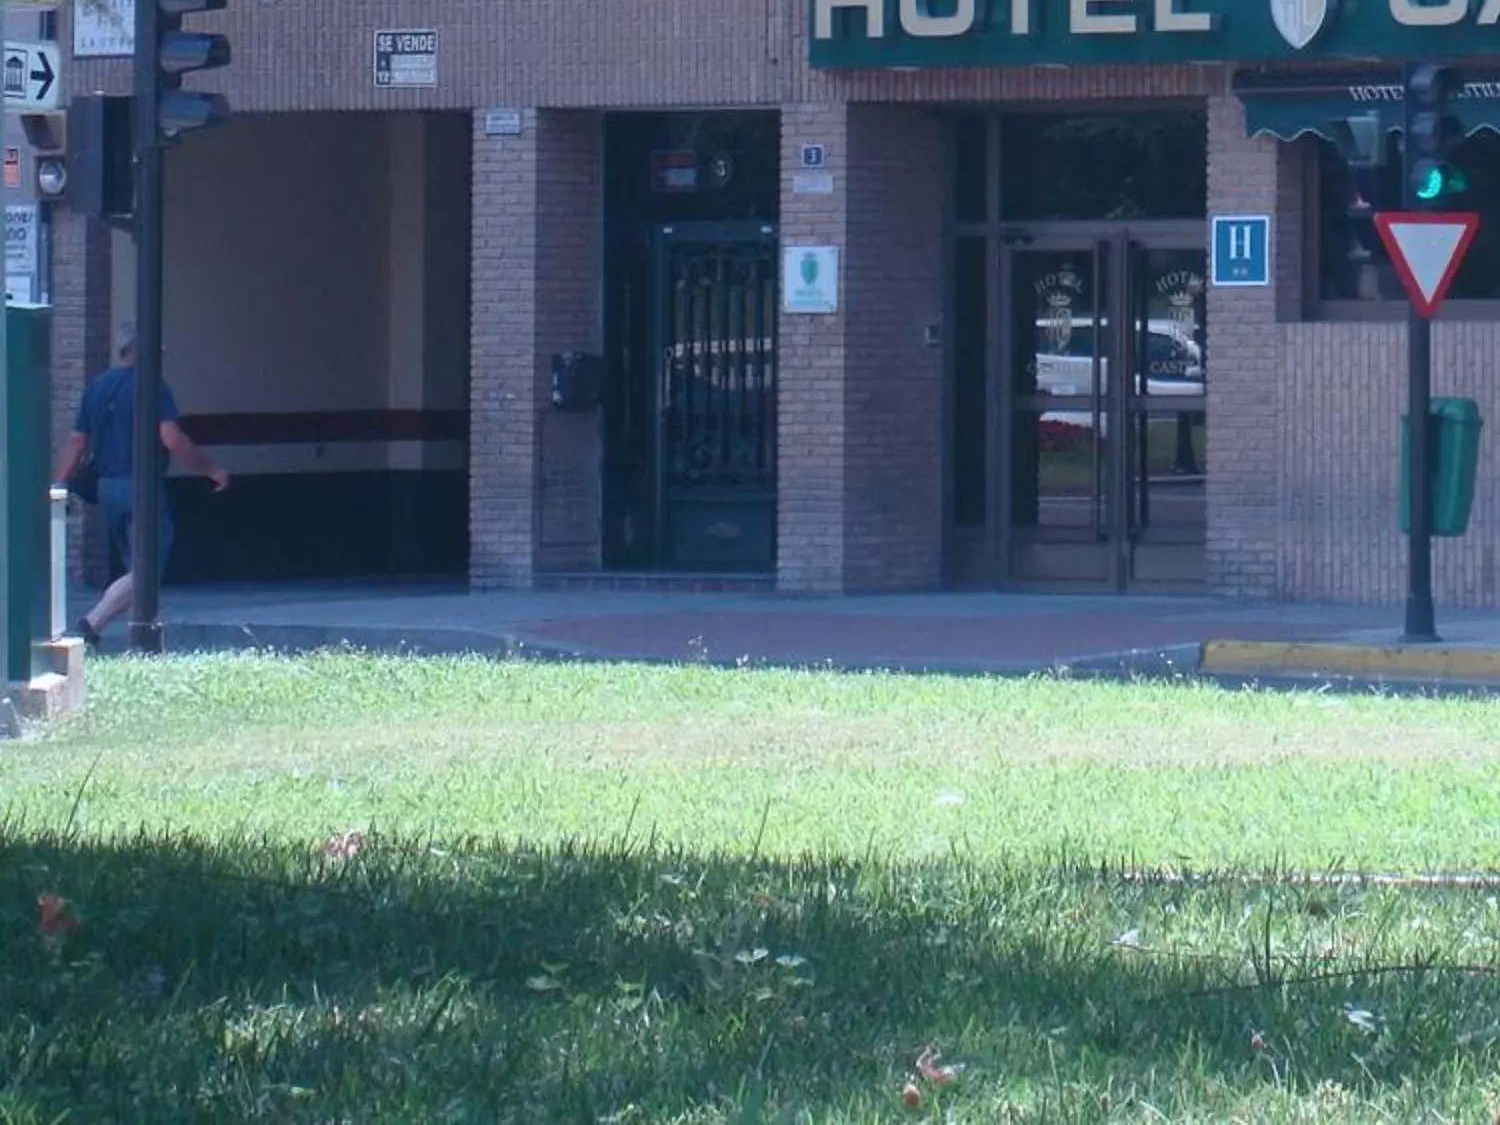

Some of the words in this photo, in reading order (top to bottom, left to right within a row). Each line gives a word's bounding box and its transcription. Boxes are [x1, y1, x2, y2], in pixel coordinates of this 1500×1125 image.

[378, 34, 394, 52] SE
[395, 34, 435, 52] VENDE
[1348, 85, 1405, 101] HOTE
[1229, 224, 1252, 261] H
